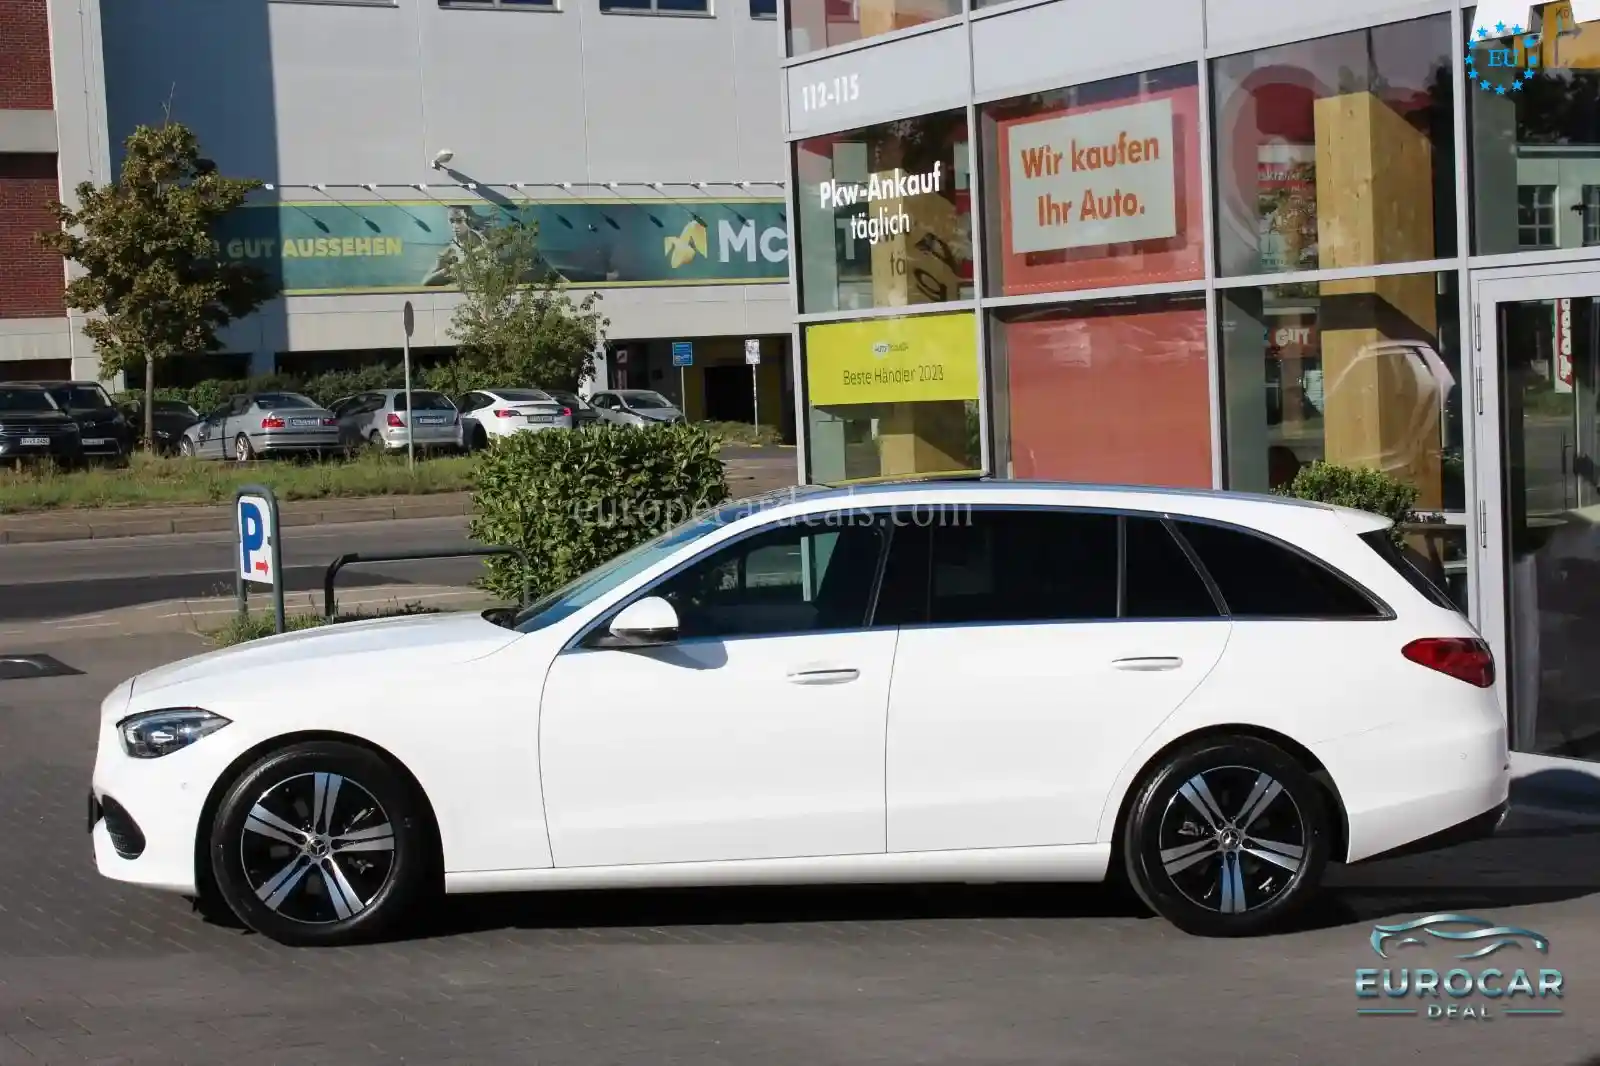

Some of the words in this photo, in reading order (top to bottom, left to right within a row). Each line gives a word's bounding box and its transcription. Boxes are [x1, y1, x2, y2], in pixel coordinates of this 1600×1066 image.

[802, 73, 860, 112] 112-115
[1021, 144, 1064, 179] Wir
[1071, 131, 1160, 173] kaufen
[819, 160, 941, 209] Pkw-Ankauf
[850, 203, 910, 245] täglich
[1037, 192, 1073, 227] Ihr
[1079, 188, 1146, 222] Auto.
[226, 237, 275, 259] GUT
[281, 236, 403, 259] AUSSEHEN
[843, 369, 872, 386] Beste
[874, 365, 916, 384] Händler
[918, 363, 944, 382] 2023
[240, 502, 264, 574] P
